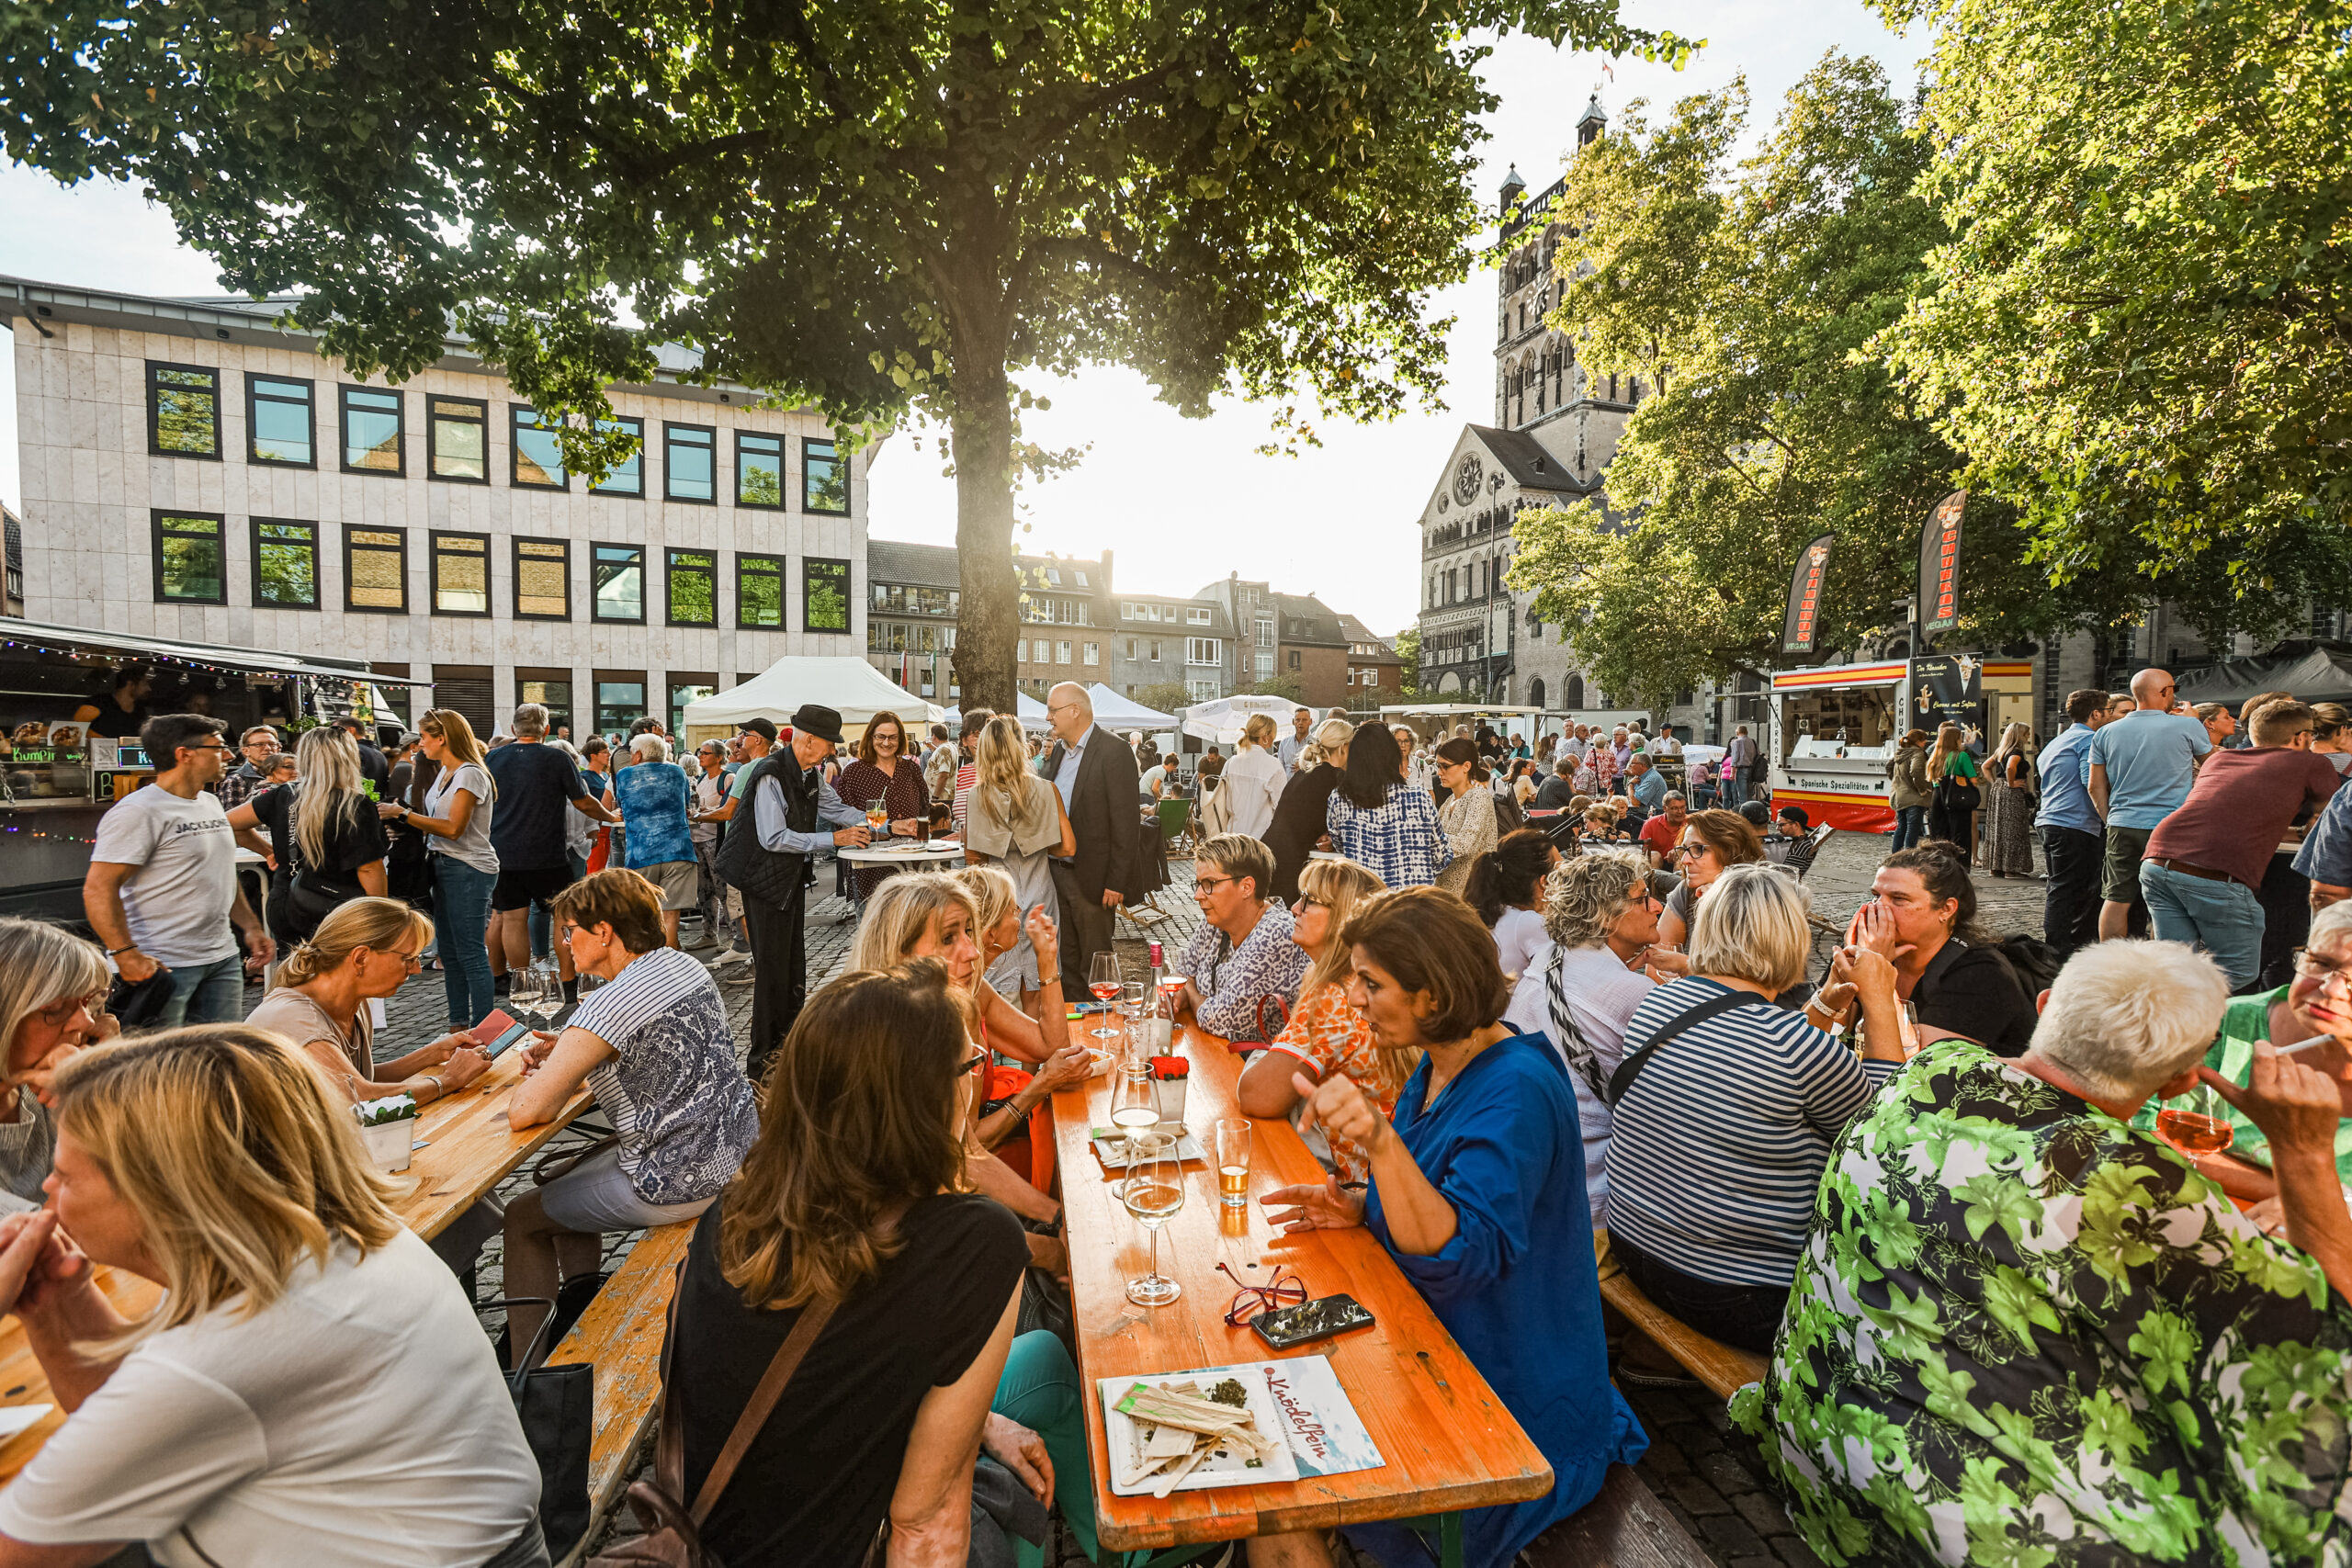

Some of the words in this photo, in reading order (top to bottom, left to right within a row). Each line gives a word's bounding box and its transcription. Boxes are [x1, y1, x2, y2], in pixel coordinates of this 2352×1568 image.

[1938, 530, 1957, 618] CHURROS
[1925, 618, 1953, 631] VEGAN
[1801, 778, 1828, 789] Spanische
[1830, 780, 1870, 791] Spezialitäten
[288, 806, 297, 846] VALENTINO
[1264, 1369, 1326, 1459] Knödelfein
